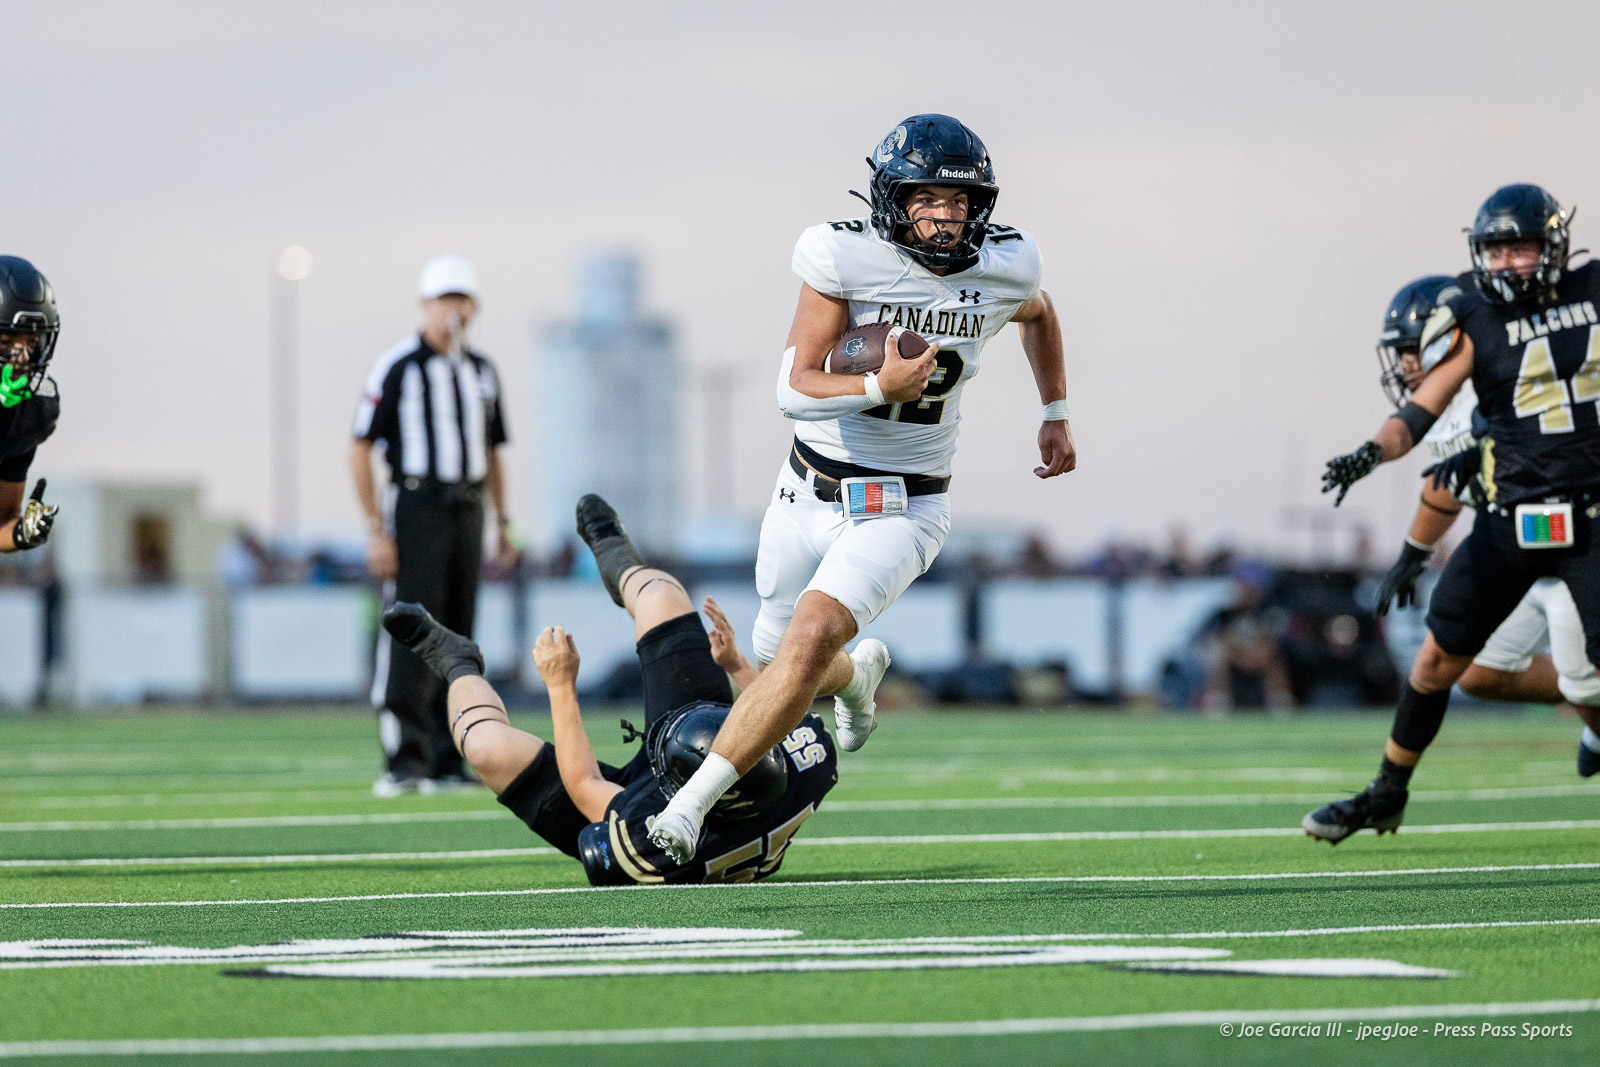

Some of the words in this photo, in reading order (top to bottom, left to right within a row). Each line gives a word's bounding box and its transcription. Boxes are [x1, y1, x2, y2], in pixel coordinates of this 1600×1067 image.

[941, 168, 975, 179] Riddell
[827, 219, 865, 234] 2
[969, 207, 989, 229] Rddell
[877, 303, 986, 338] CANADIAN
[858, 348, 966, 425] 2
